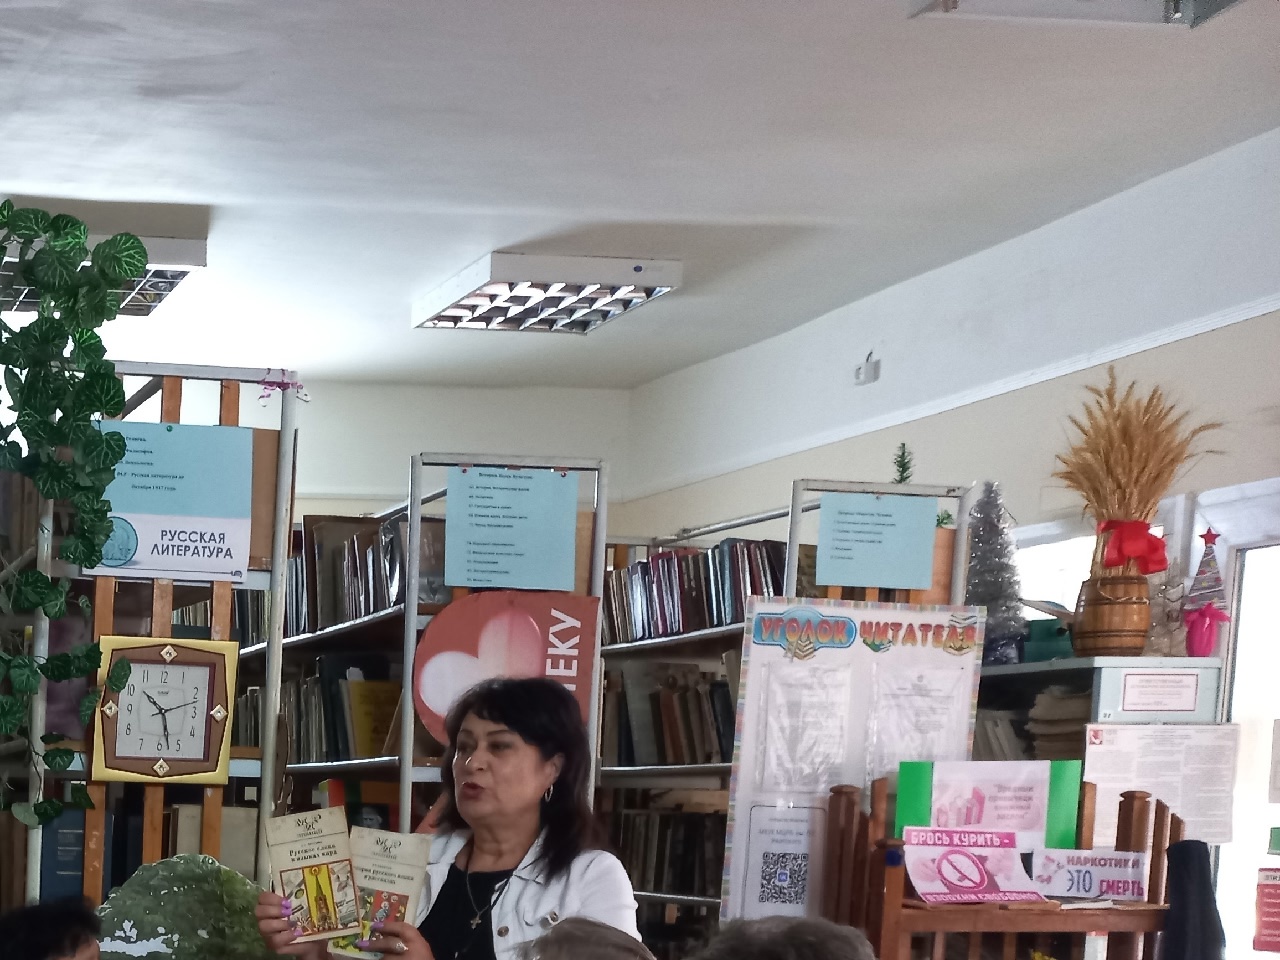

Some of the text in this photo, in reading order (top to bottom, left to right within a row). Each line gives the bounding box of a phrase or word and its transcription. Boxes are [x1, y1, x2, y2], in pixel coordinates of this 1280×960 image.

[160, 530, 225, 545] РУССКАЯ
[151, 544, 233, 560] ЛИТЕРАТУРА
[760, 616, 977, 649] УГОЛОК ЧИТАТЕЛЯ
[545, 608, 582, 691] ЕКУ
[142, 669, 149, 683] 11
[160, 671, 169, 684] 12
[181, 671, 185, 683] 1
[127, 683, 136, 696] 10
[193, 686, 199, 700] 2
[126, 703, 133, 714] 9
[191, 706, 197, 719] 3
[125, 723, 132, 735] 8
[189, 725, 195, 738] 4
[138, 738, 144, 751] 7
[156, 740, 163, 751] 6
[175, 739, 181, 752] 5
[911, 831, 950, 844] БРОСЬ
[953, 833, 1001, 846] КУРИТЬ
[1067, 855, 1140, 869] НАРКОТИКИ
[1066, 868, 1145, 896] ЭТО СМЕРТЬ
